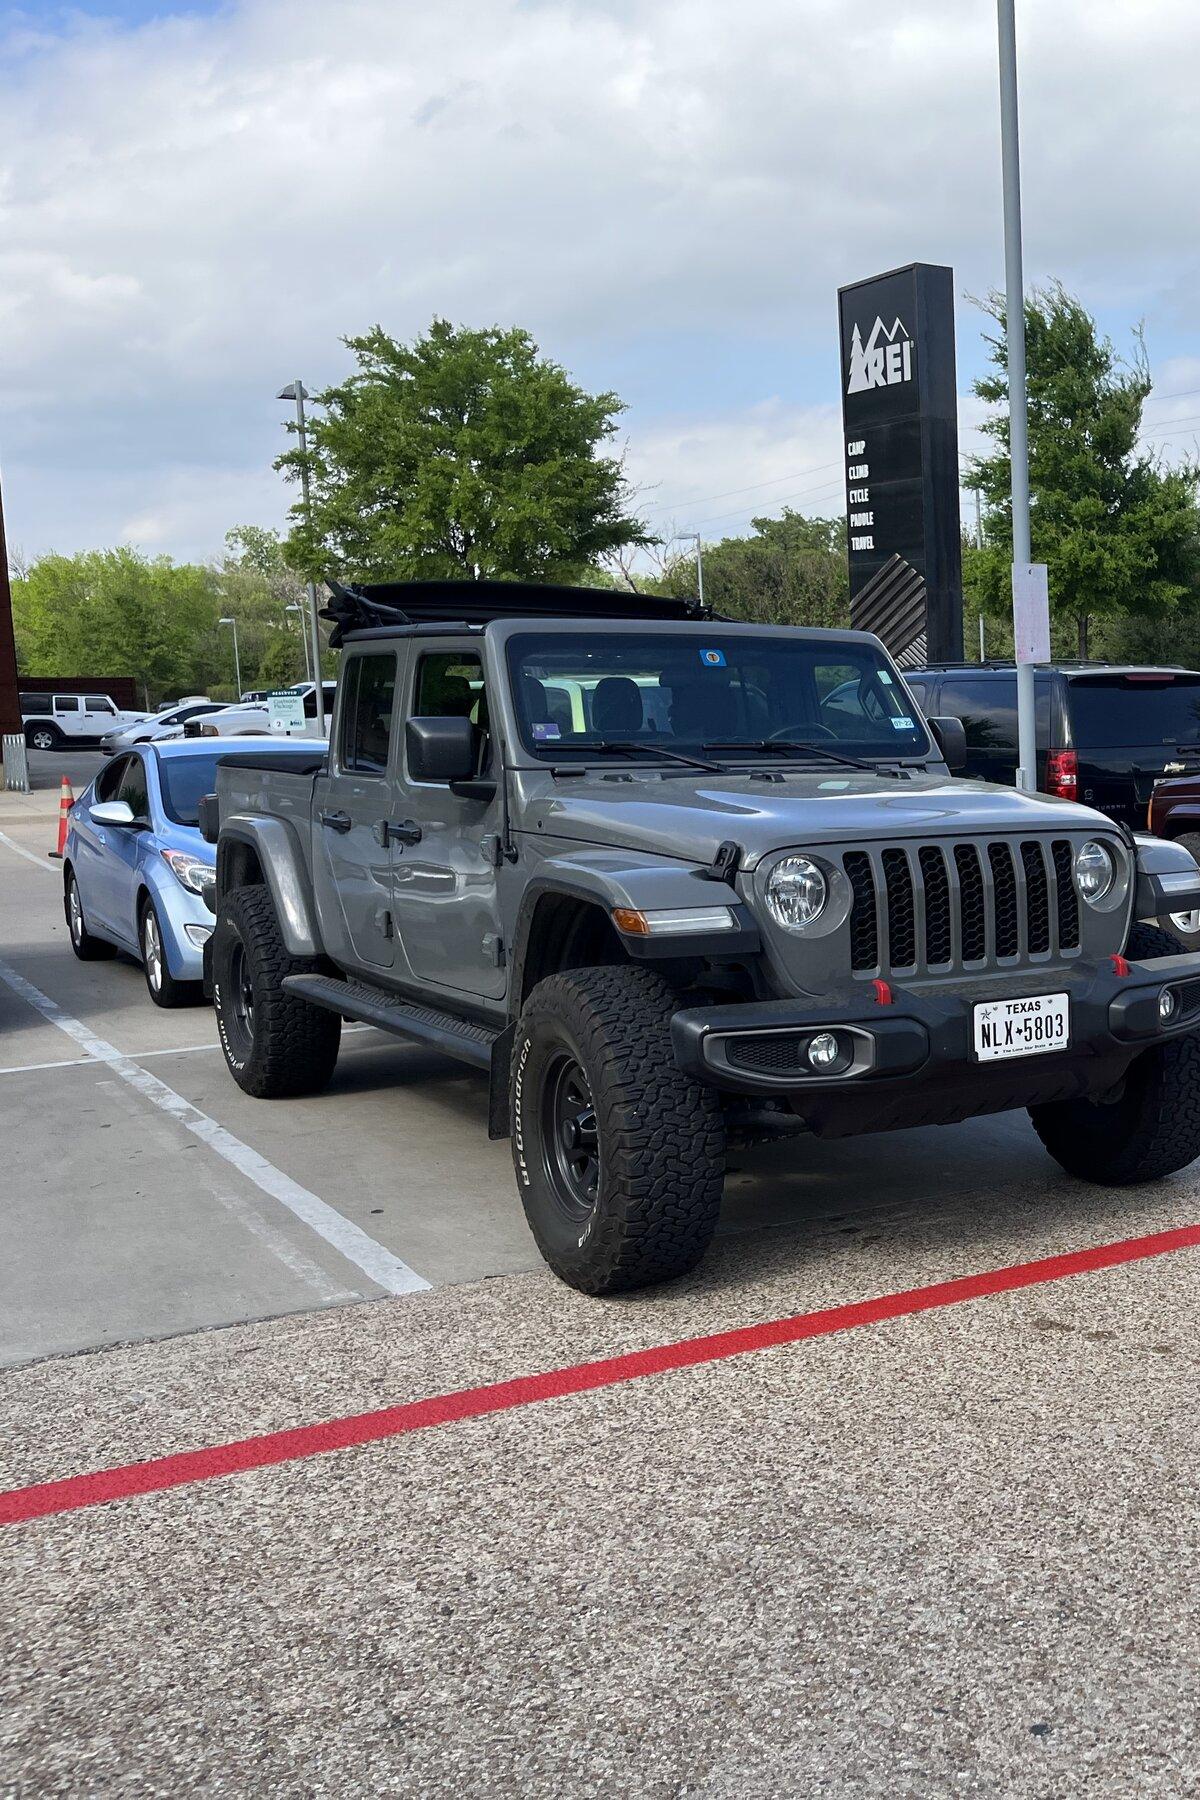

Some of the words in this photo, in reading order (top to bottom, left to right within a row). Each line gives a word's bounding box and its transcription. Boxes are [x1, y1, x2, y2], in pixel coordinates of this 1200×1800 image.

[847, 440, 866, 456] CAMP
[849, 464, 869, 480] CLIMB
[849, 488, 870, 503] CYCLE
[850, 511, 874, 527] PADDLE
[851, 535, 875, 550] TRAVEL
[1006, 1001, 1041, 1014] TEXAS
